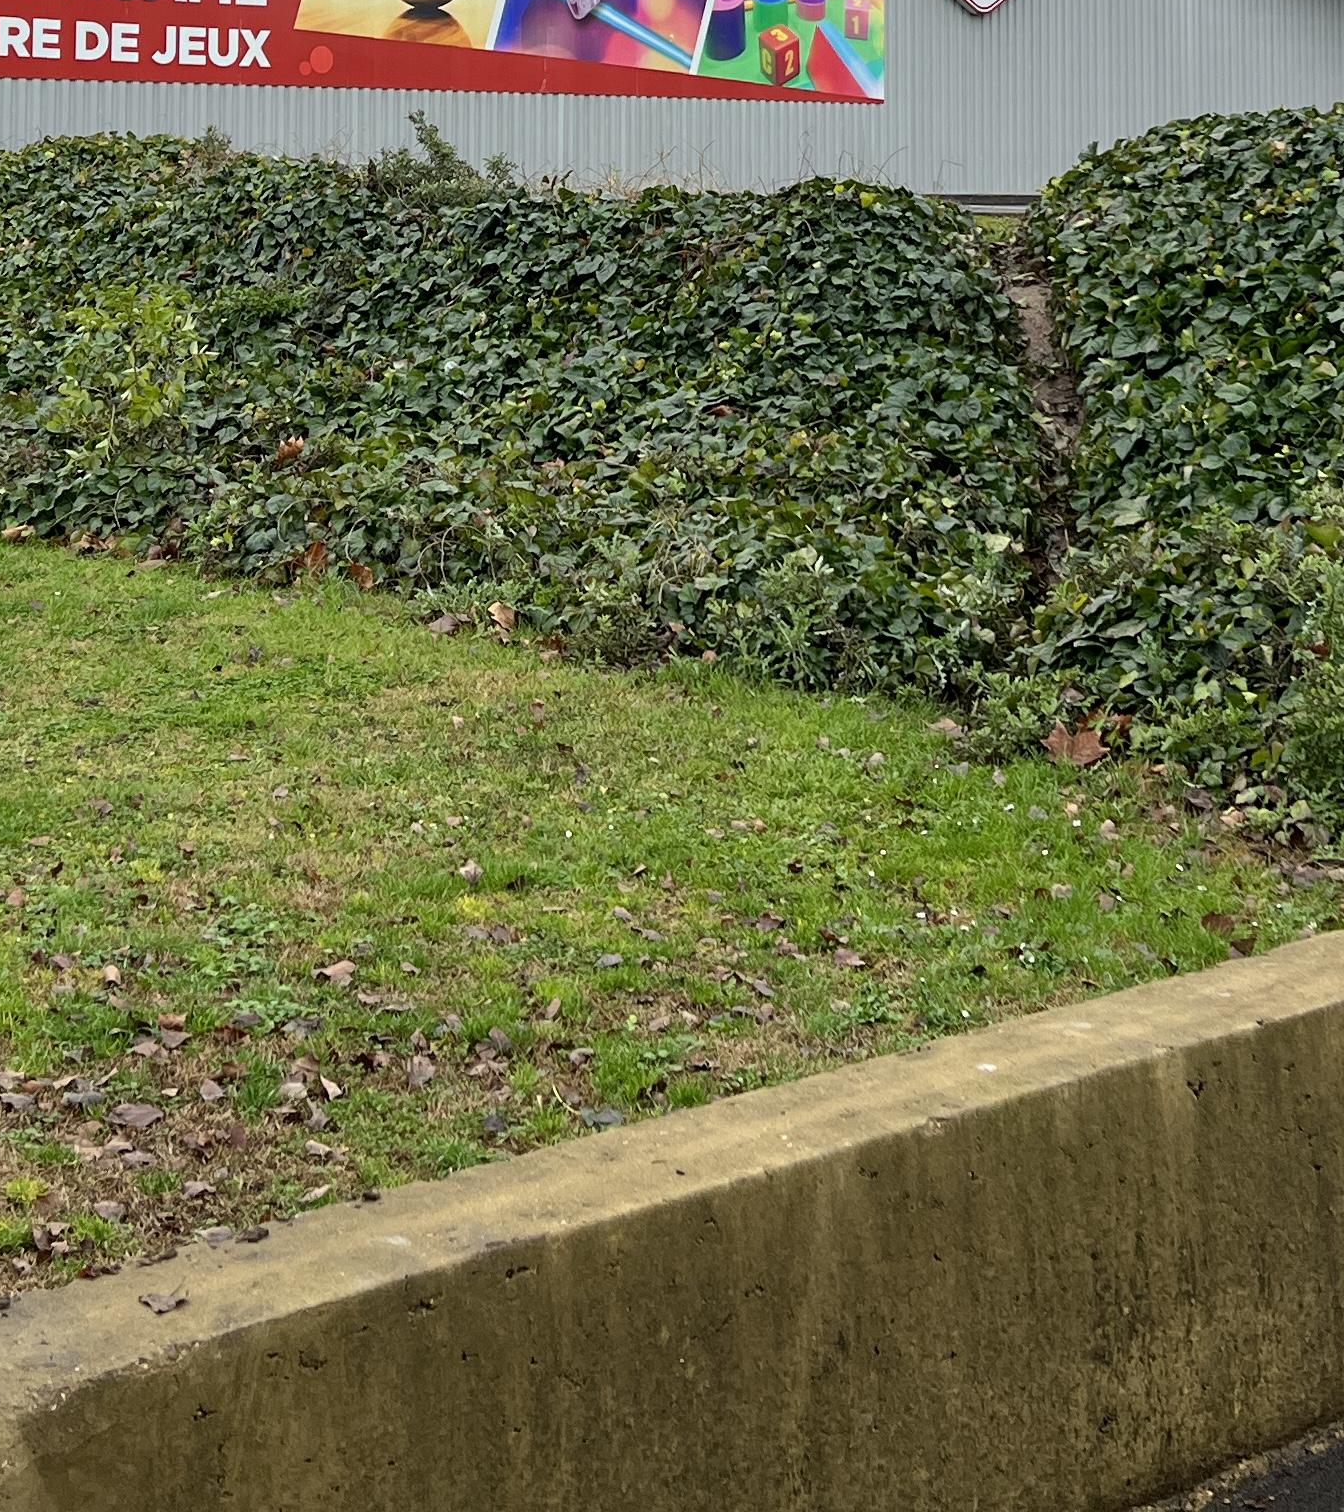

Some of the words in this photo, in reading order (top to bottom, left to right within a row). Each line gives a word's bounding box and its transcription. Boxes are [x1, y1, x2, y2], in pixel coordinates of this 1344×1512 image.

[74, 20, 140, 63] DE
[152, 25, 271, 68] JEUX
[784, 49, 794, 77] 2
